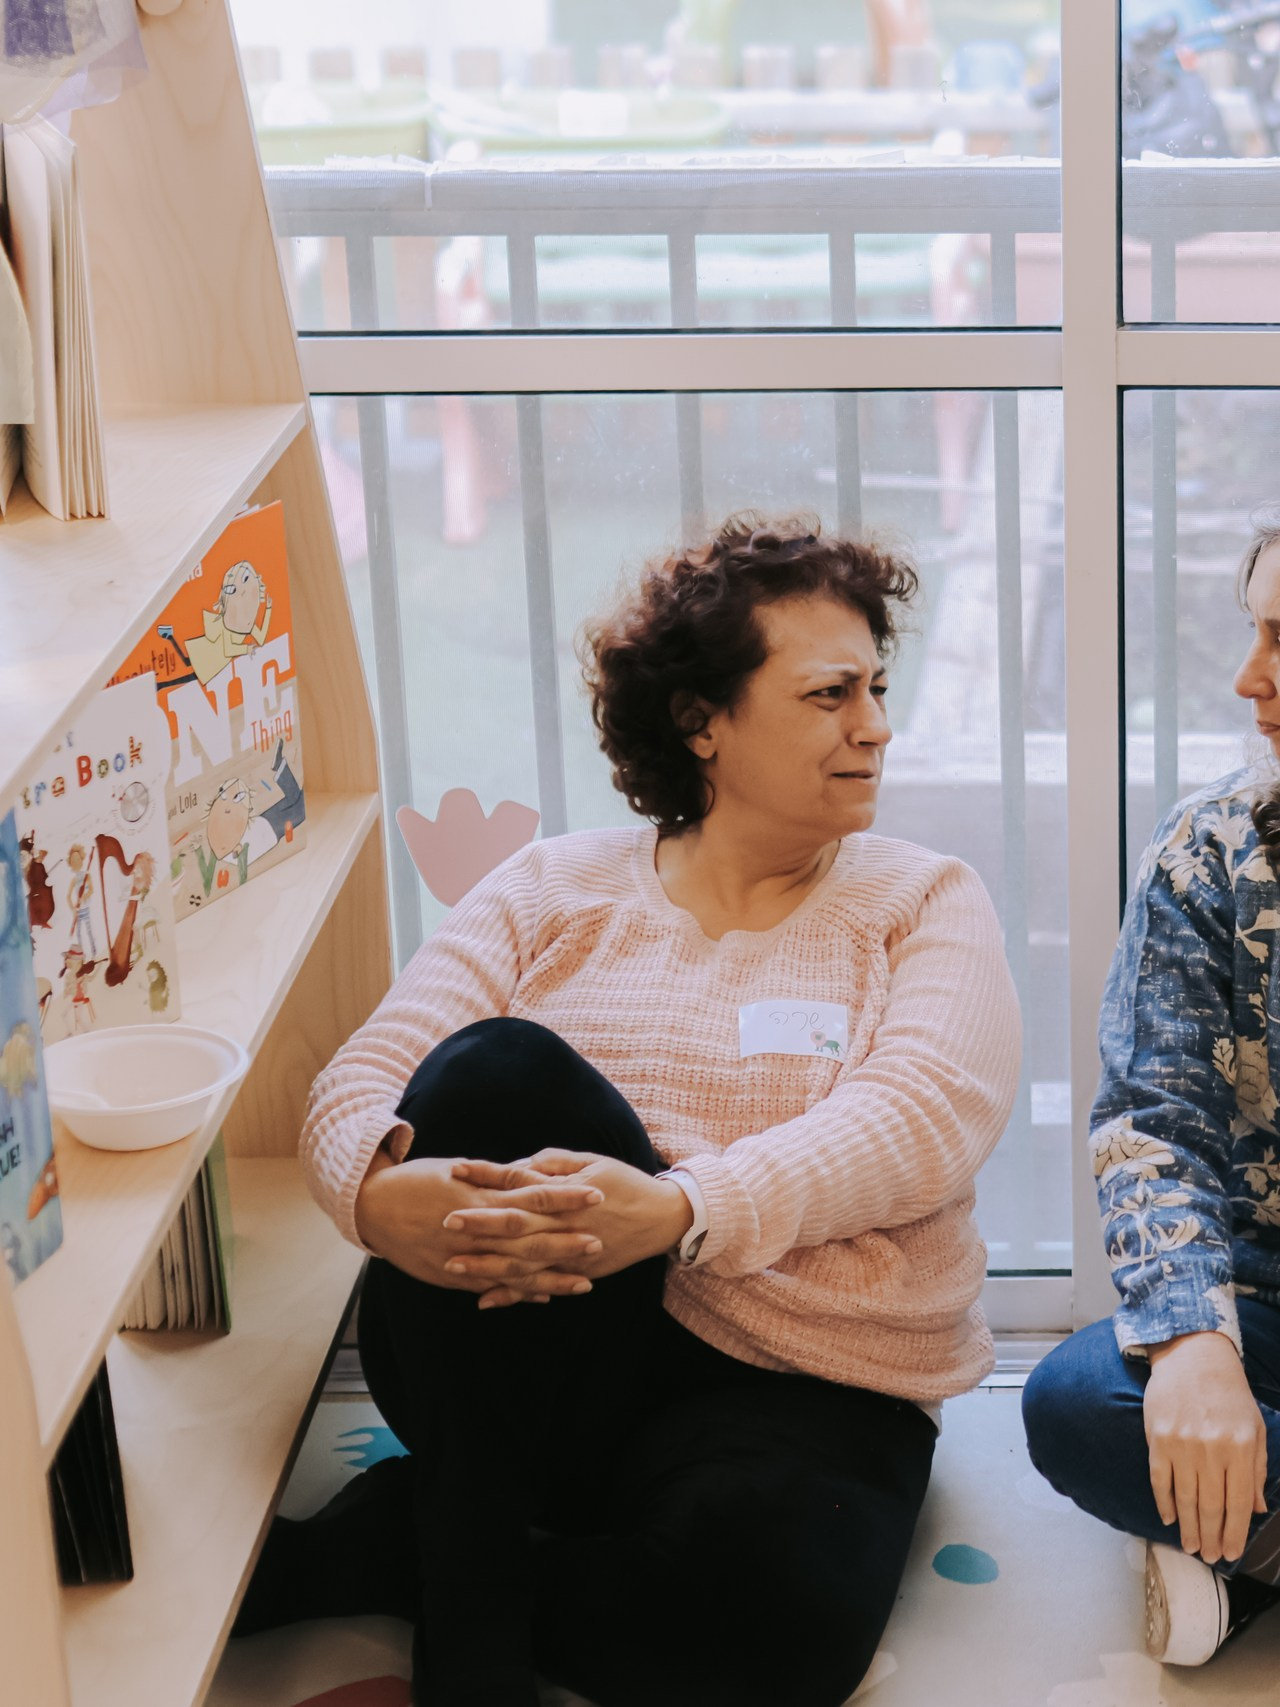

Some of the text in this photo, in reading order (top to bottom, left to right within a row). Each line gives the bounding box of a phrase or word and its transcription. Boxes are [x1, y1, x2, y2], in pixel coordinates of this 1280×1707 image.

[167, 631, 296, 788] NE
[251, 709, 293, 753] Thing
[76, 735, 144, 788] Book
[178, 791, 198, 814] Lola
